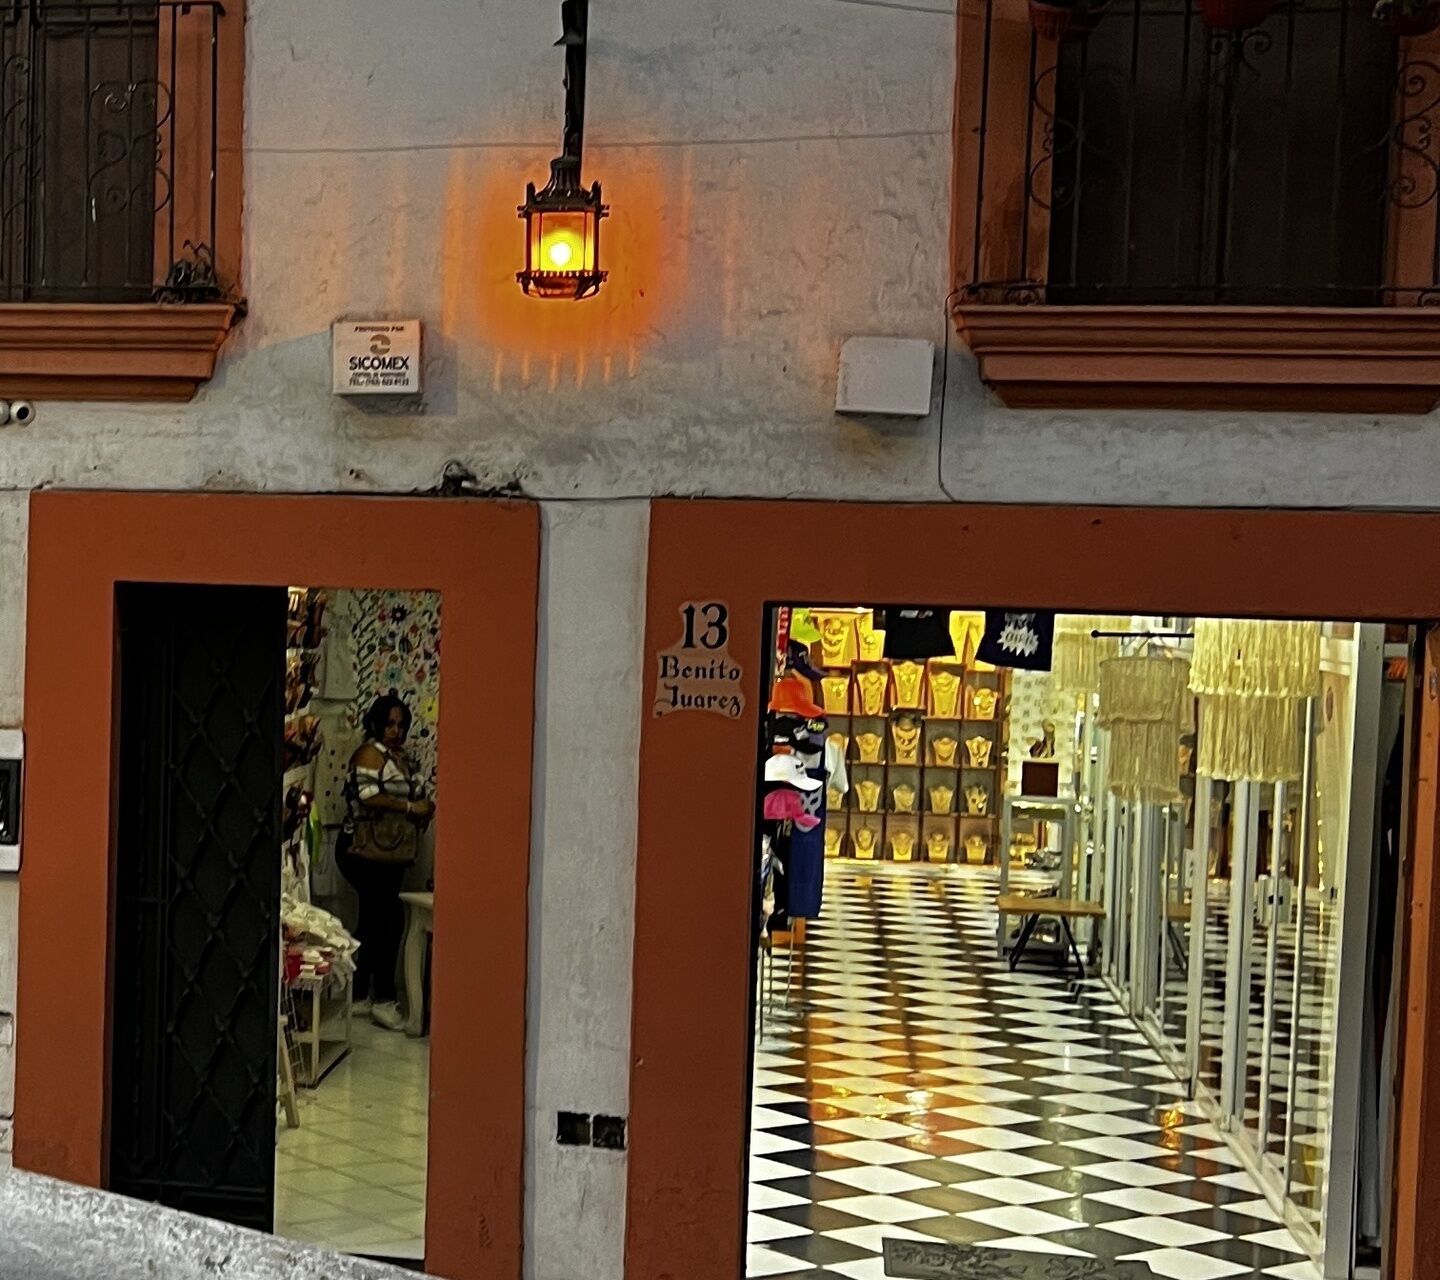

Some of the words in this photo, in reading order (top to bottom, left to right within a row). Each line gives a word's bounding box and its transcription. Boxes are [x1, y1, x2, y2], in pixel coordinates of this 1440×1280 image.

[349, 356, 410, 371] SICOMEX
[681, 603, 728, 649] 13
[660, 655, 740, 680] Benito
[662, 683, 741, 717] Juarez
